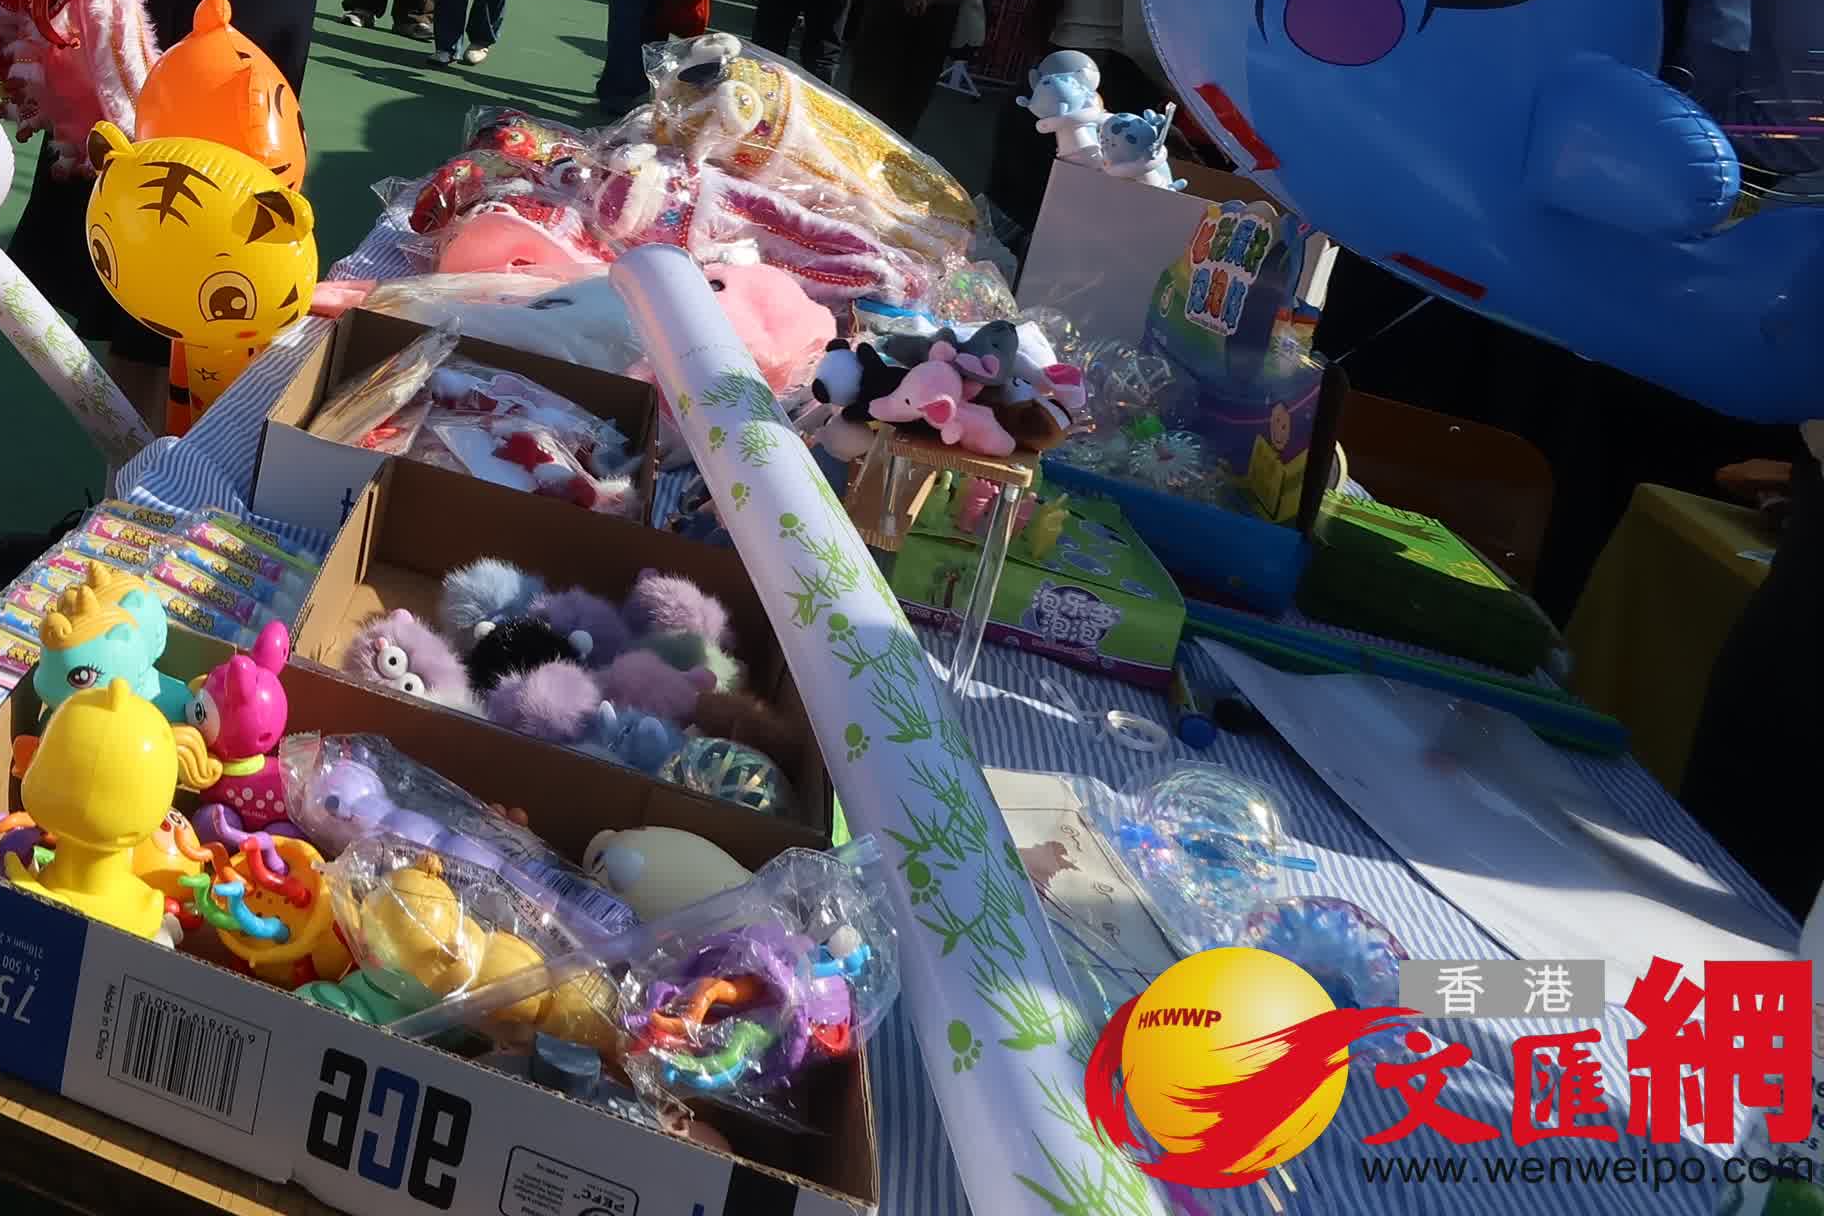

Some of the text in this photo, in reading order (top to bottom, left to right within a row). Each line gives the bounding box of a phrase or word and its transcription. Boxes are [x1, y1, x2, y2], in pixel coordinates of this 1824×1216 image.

[1, 955, 23, 974] 500
[33, 967, 41, 982] 5
[306, 1047, 472, 1211] ace
